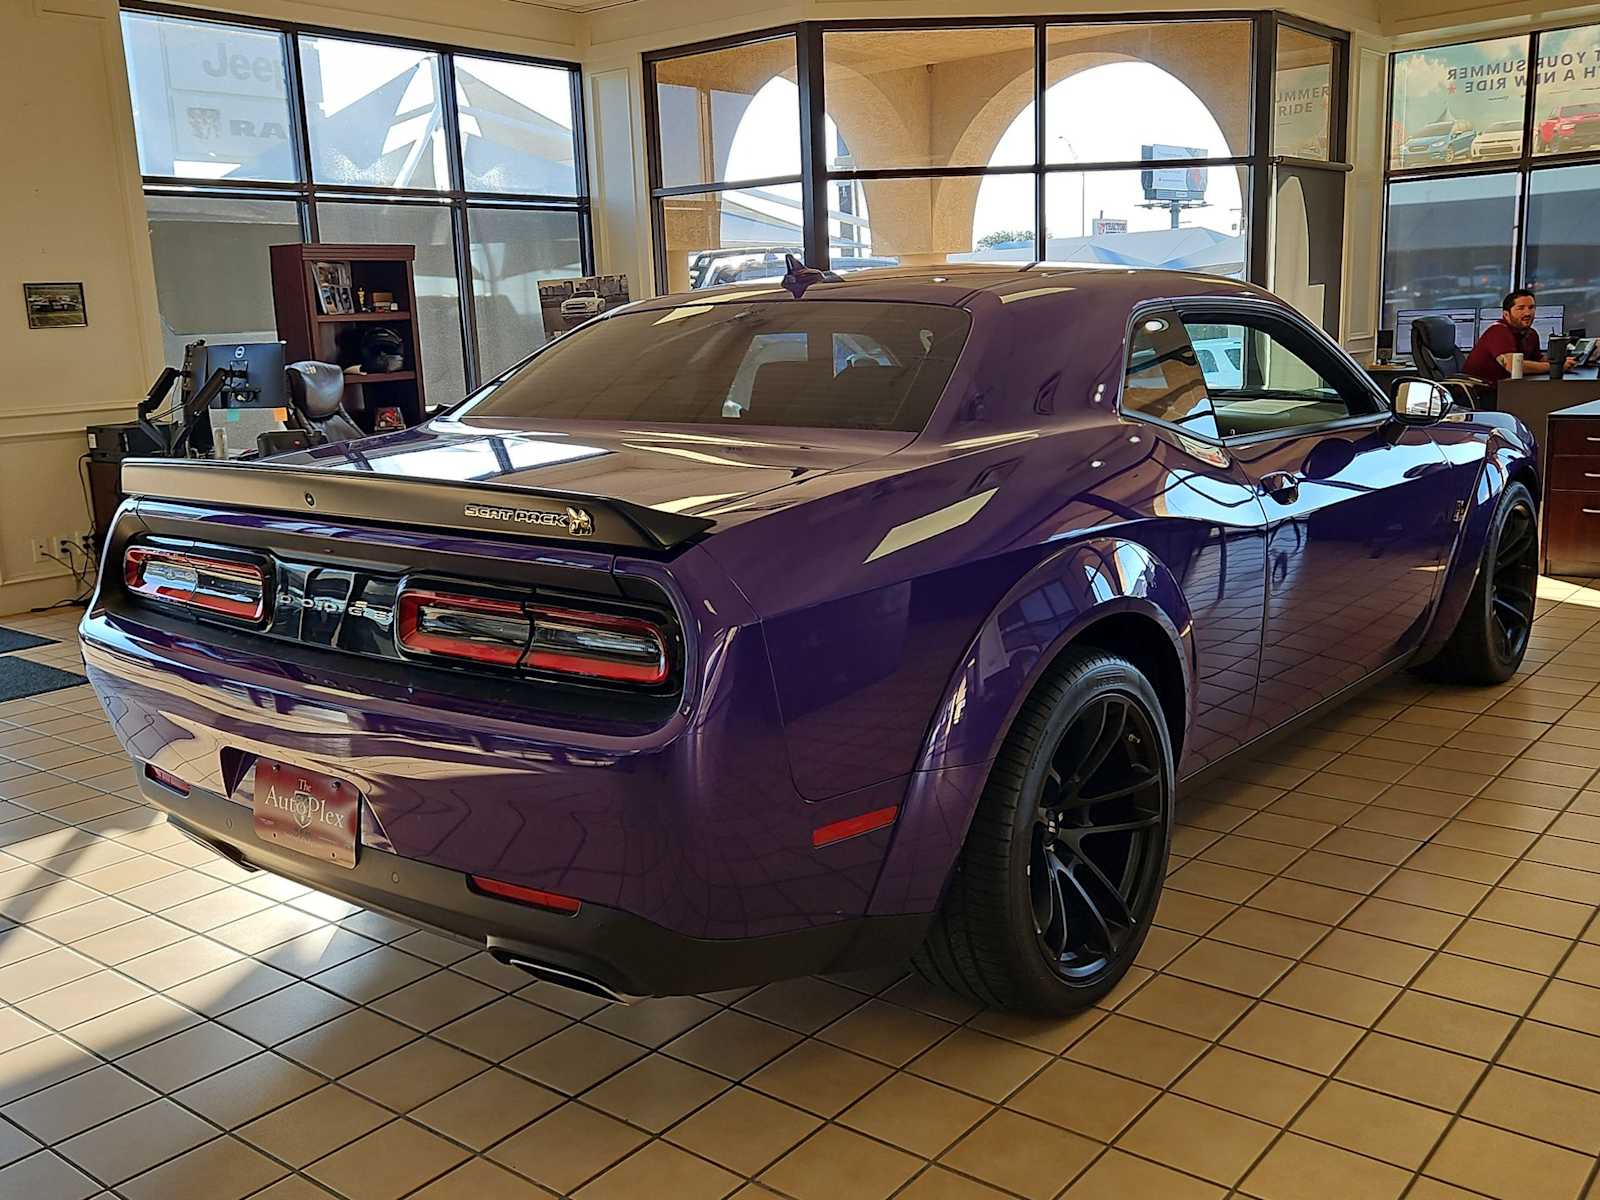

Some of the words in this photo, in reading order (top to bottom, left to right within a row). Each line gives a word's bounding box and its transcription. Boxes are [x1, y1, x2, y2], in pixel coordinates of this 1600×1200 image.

[1279, 102, 1313, 117] RIDE
[464, 504, 513, 520] SCAT
[514, 510, 569, 528] PACK
[279, 593, 394, 625] DODGE
[297, 778, 313, 792] The
[264, 785, 345, 828] AutoPlex
